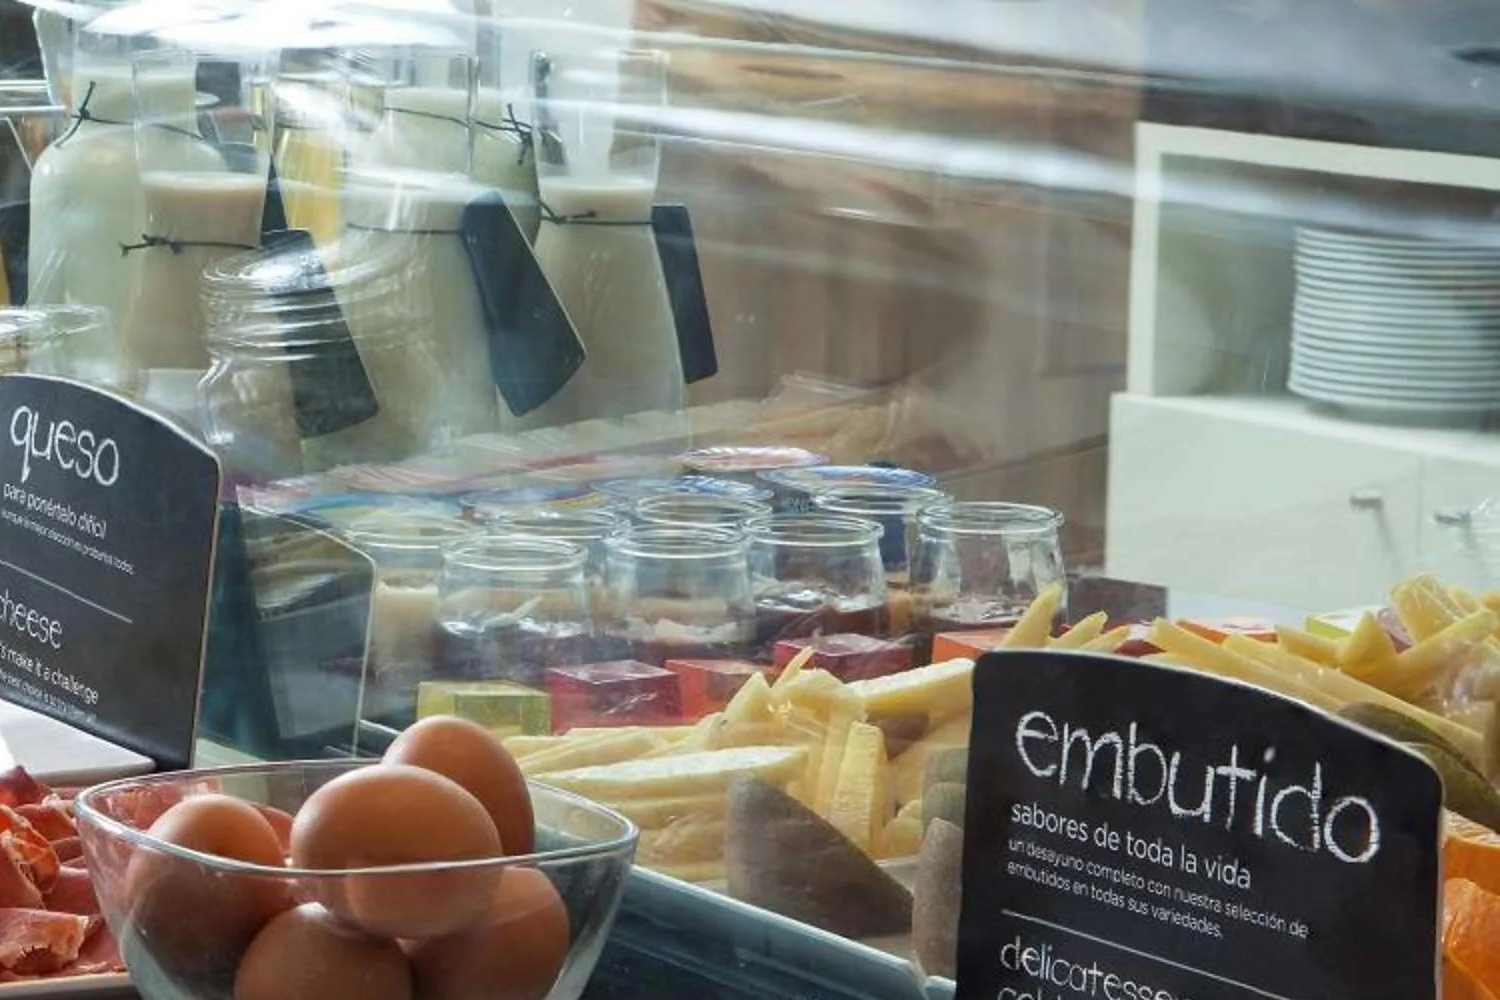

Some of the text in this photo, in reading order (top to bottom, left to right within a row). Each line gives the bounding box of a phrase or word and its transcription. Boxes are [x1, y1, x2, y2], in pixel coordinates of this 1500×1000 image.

[10, 405, 119, 487] queso
[3, 483, 26, 505] para
[1015, 710, 1381, 864] embutido
[1011, 801, 1251, 889] sabores de toda la vida
[1007, 860, 1071, 891] embutidos
[1072, 880, 1088, 895] en
[1091, 883, 1125, 908] todas
[1126, 897, 1149, 916] sus
[1008, 839, 1308, 939] un desayuno completo con nuestra selección de
